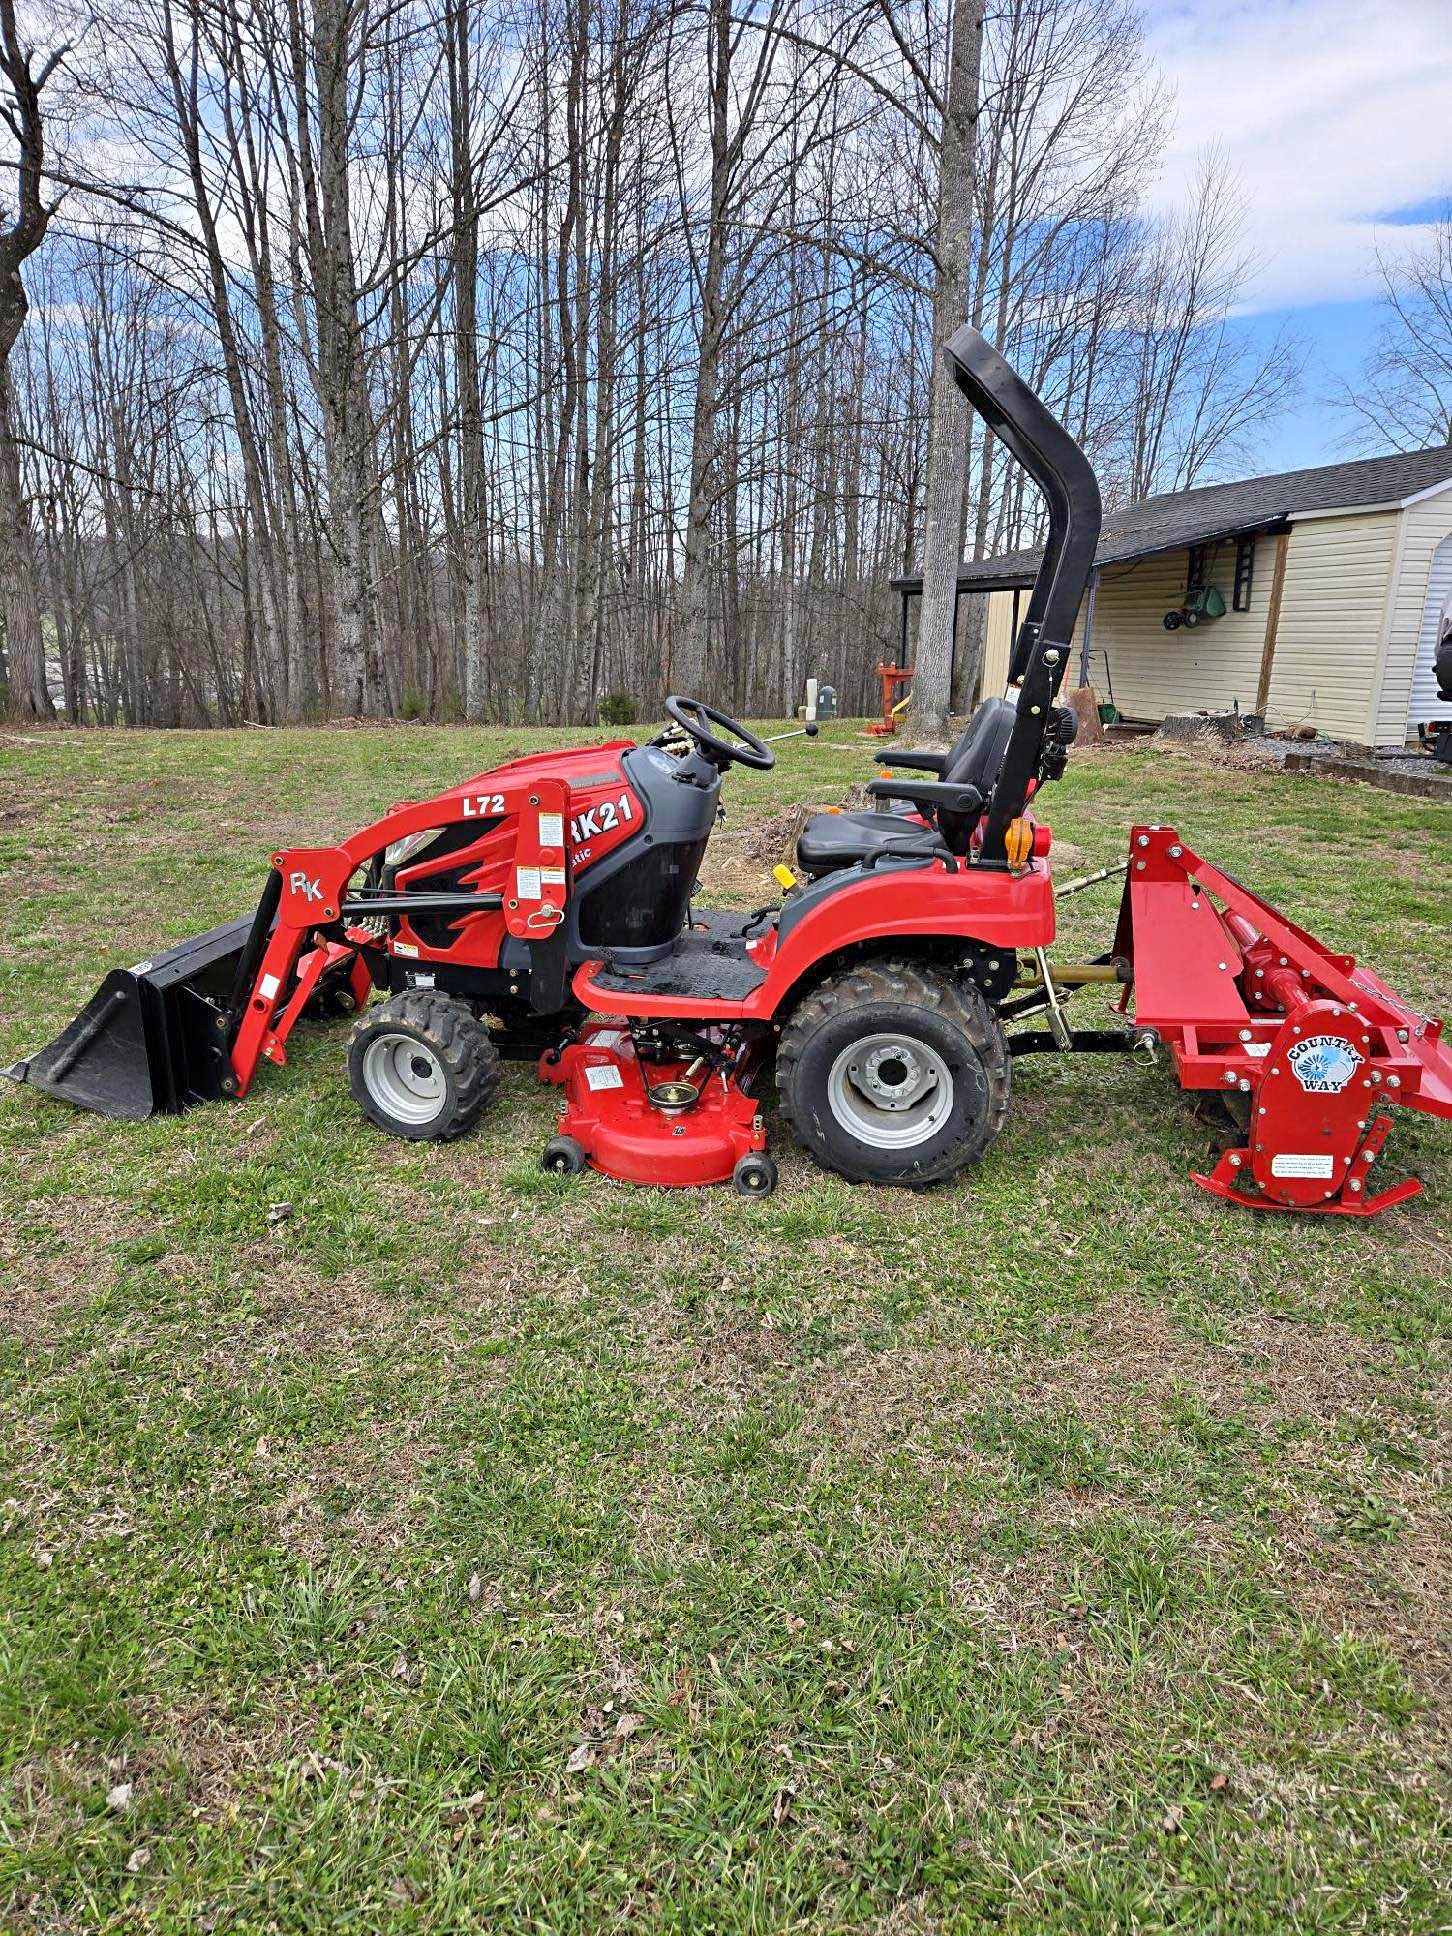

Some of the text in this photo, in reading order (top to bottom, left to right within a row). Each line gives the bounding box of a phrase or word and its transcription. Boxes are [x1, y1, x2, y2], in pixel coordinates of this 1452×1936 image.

[463, 794, 505, 817] L72
[290, 872, 325, 902] RK
[1288, 1037, 1364, 1063] COUNTRY
[1303, 1079, 1343, 1092] WAY
